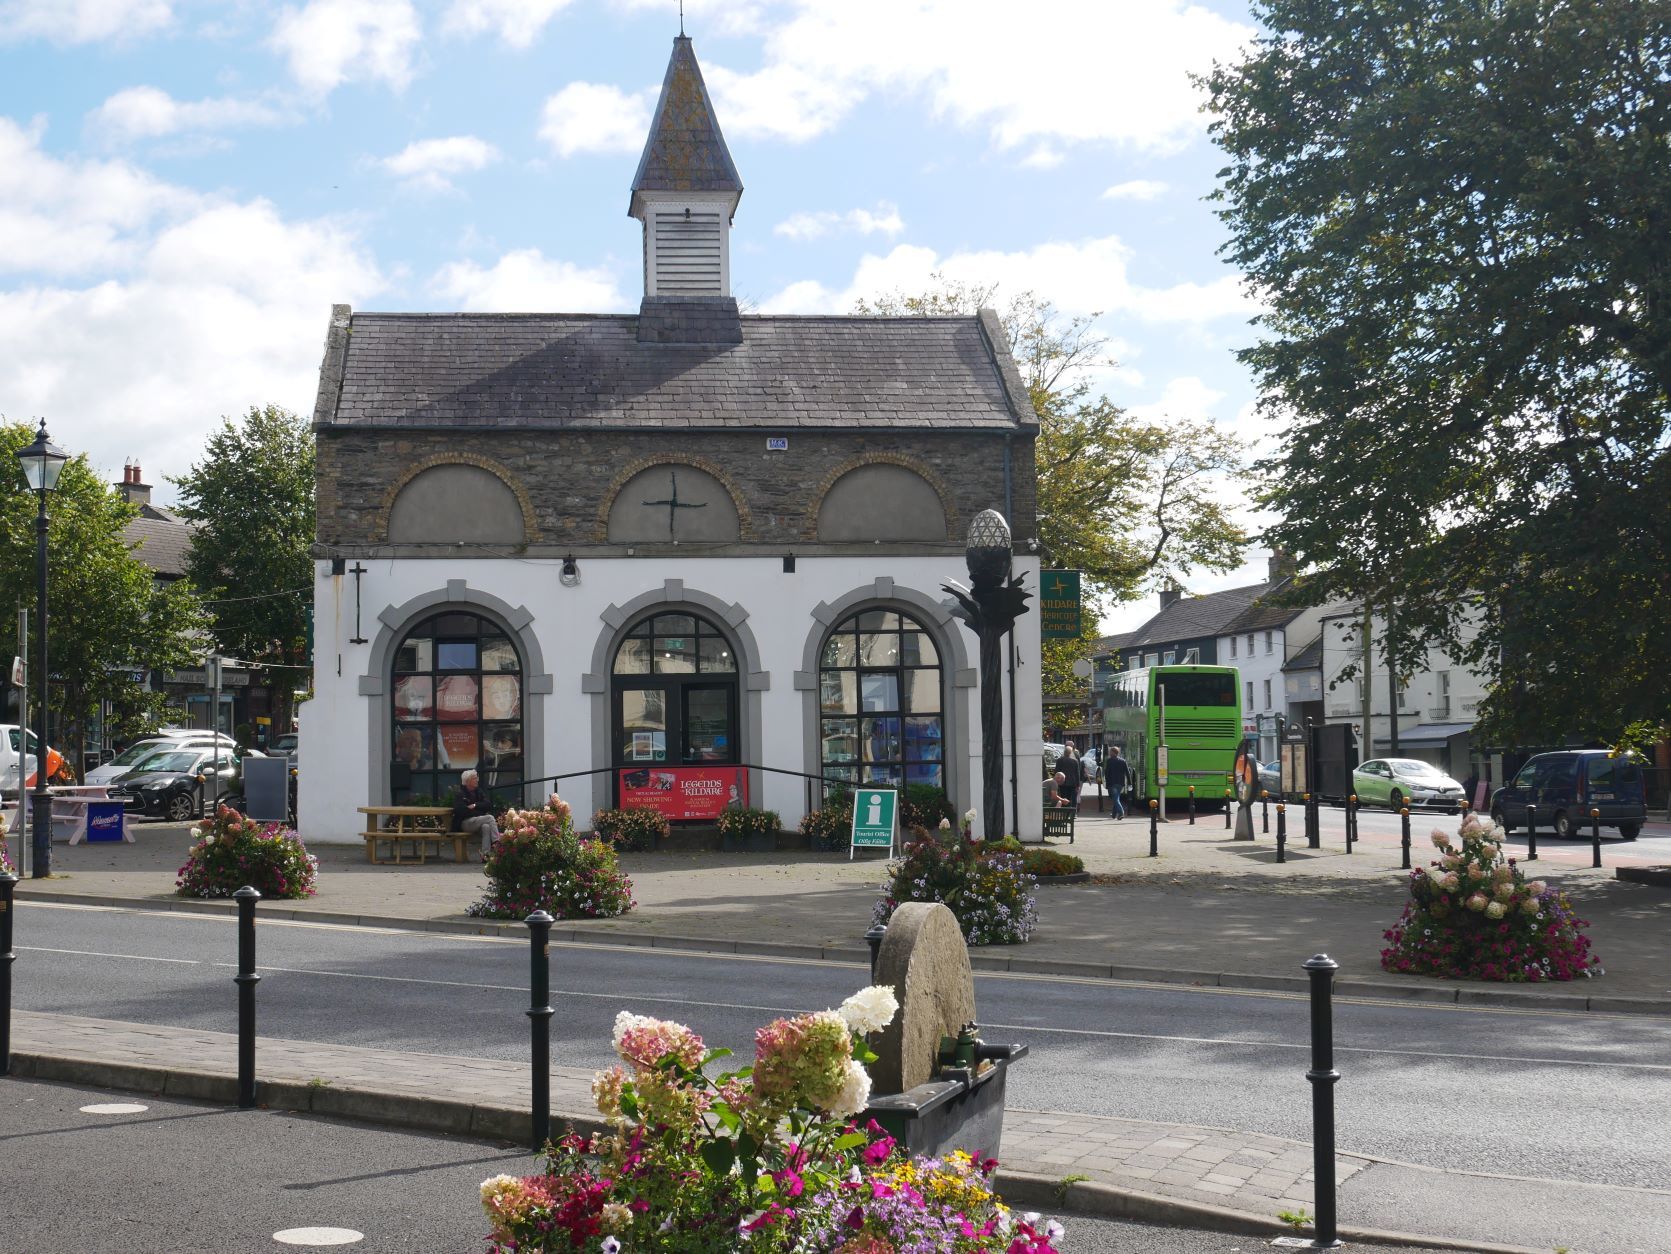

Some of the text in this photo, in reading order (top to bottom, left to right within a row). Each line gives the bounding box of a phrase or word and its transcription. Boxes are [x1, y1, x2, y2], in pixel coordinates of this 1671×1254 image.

[1040, 600, 1077, 608] KILDARE
[679, 780, 722, 789] LEGENDS
[685, 788, 723, 796] KILDARE
